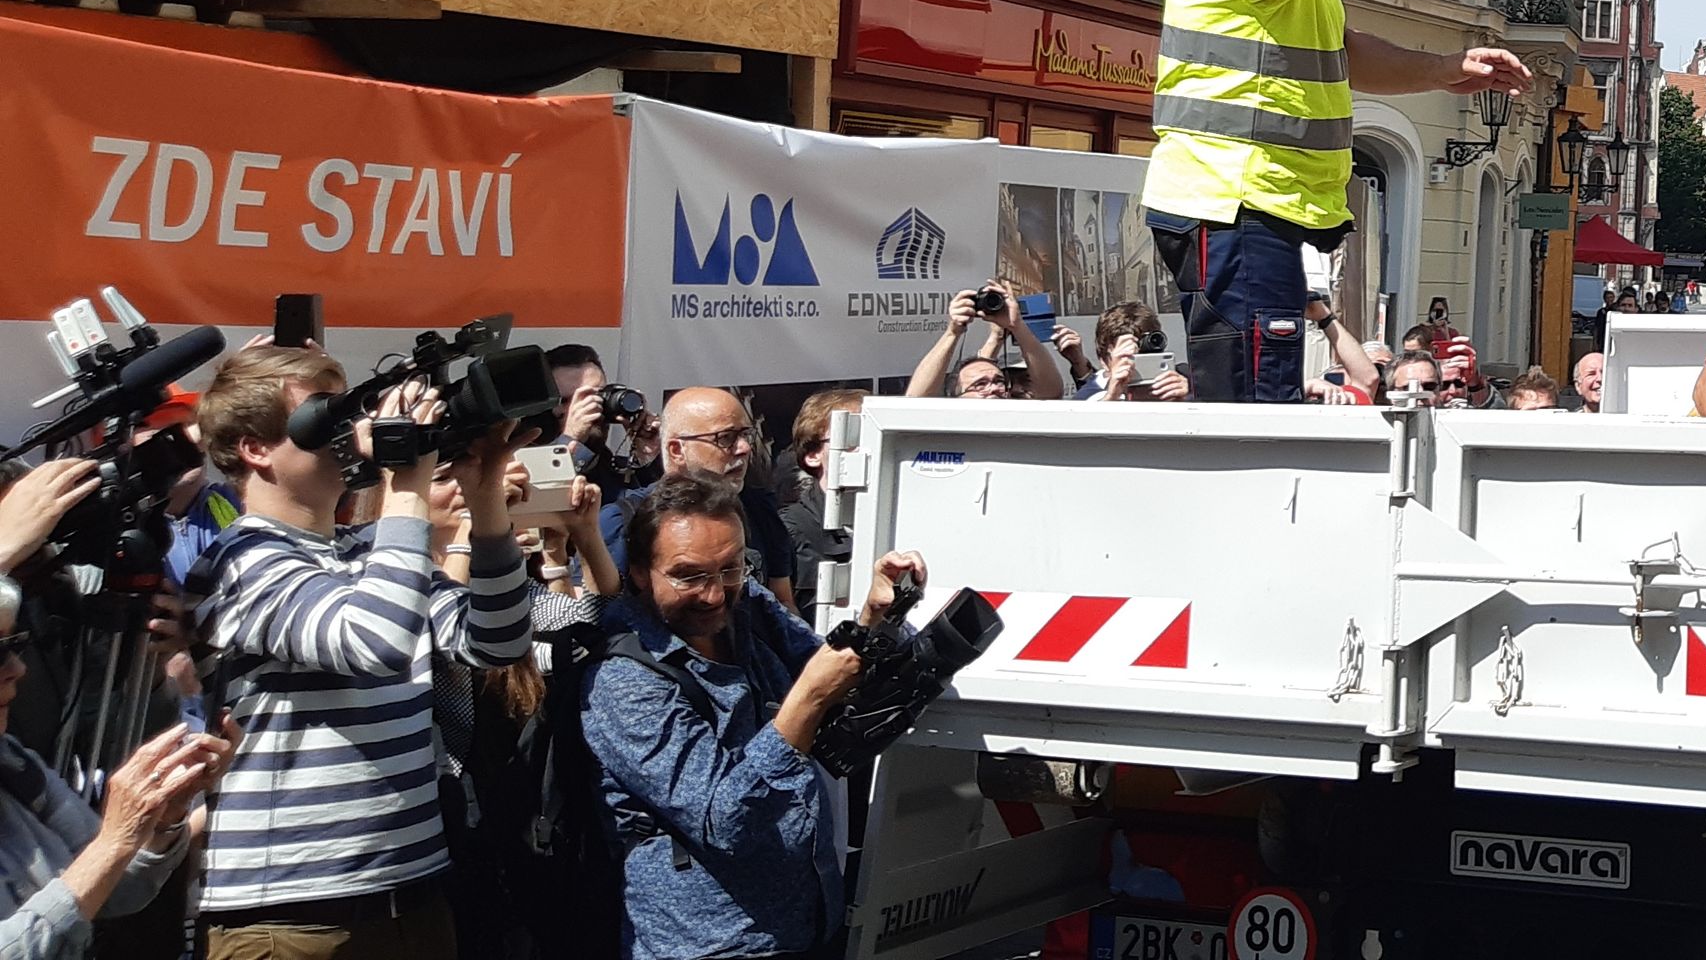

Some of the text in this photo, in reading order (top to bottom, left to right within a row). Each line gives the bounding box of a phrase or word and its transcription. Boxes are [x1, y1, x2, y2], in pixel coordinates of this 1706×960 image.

[1036, 29, 1152, 87] Madame Tussauds
[86, 136, 521, 257] ZDE STAVÍ
[671, 294, 820, 319] MS architekti s.r.o.
[1459, 839, 1621, 879] navara
[1121, 923, 1184, 960] 2BK
[1245, 904, 1296, 955] 80
